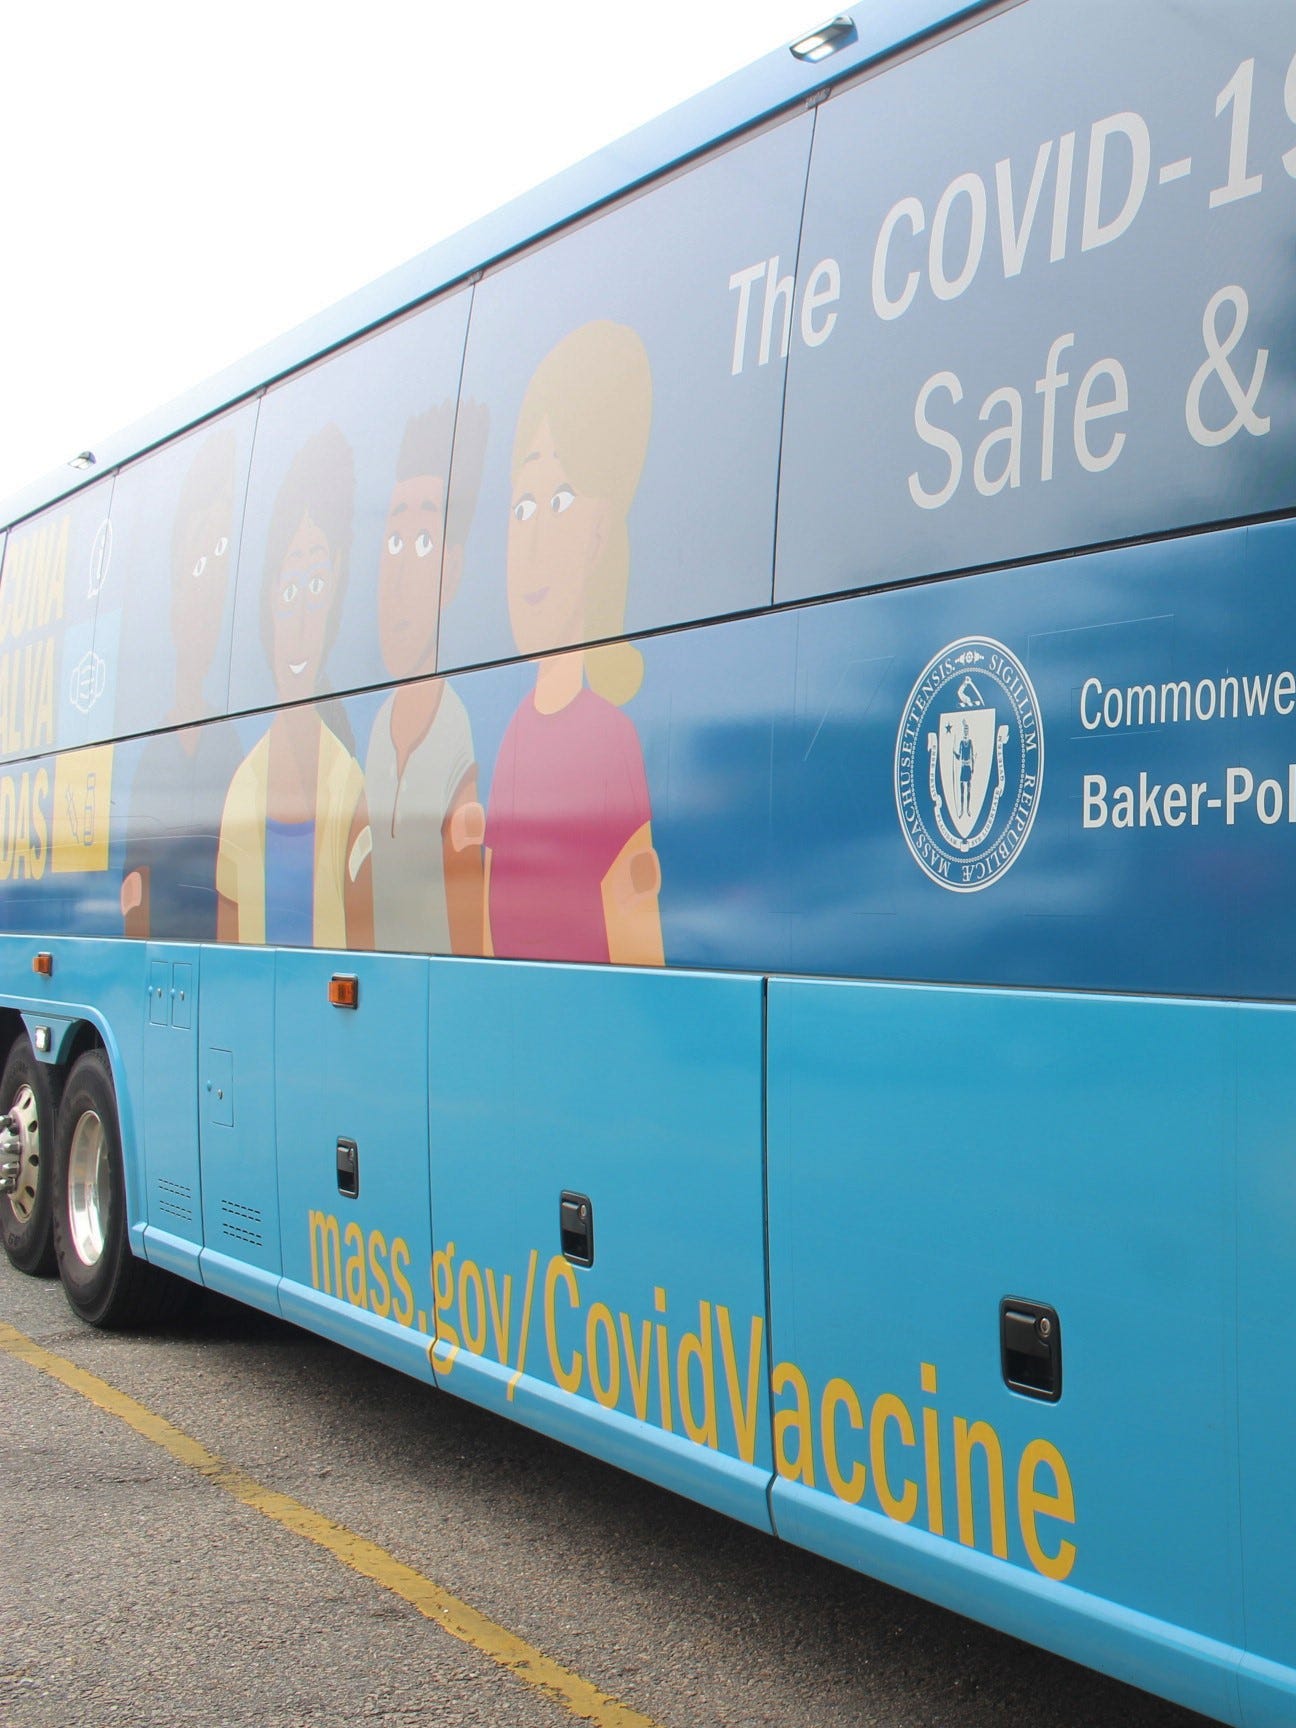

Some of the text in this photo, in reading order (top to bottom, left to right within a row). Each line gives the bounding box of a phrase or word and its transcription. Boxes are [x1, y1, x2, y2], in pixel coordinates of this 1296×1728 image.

[728, 255, 841, 376] The
[907, 333, 1129, 510] Safe
[1185, 285, 1271, 447] &
[989, 655, 1037, 752] SIGILLUM
[0, 767, 49, 880] DAS
[308, 1209, 1077, 1580] mass.gov/CovidVaccine
